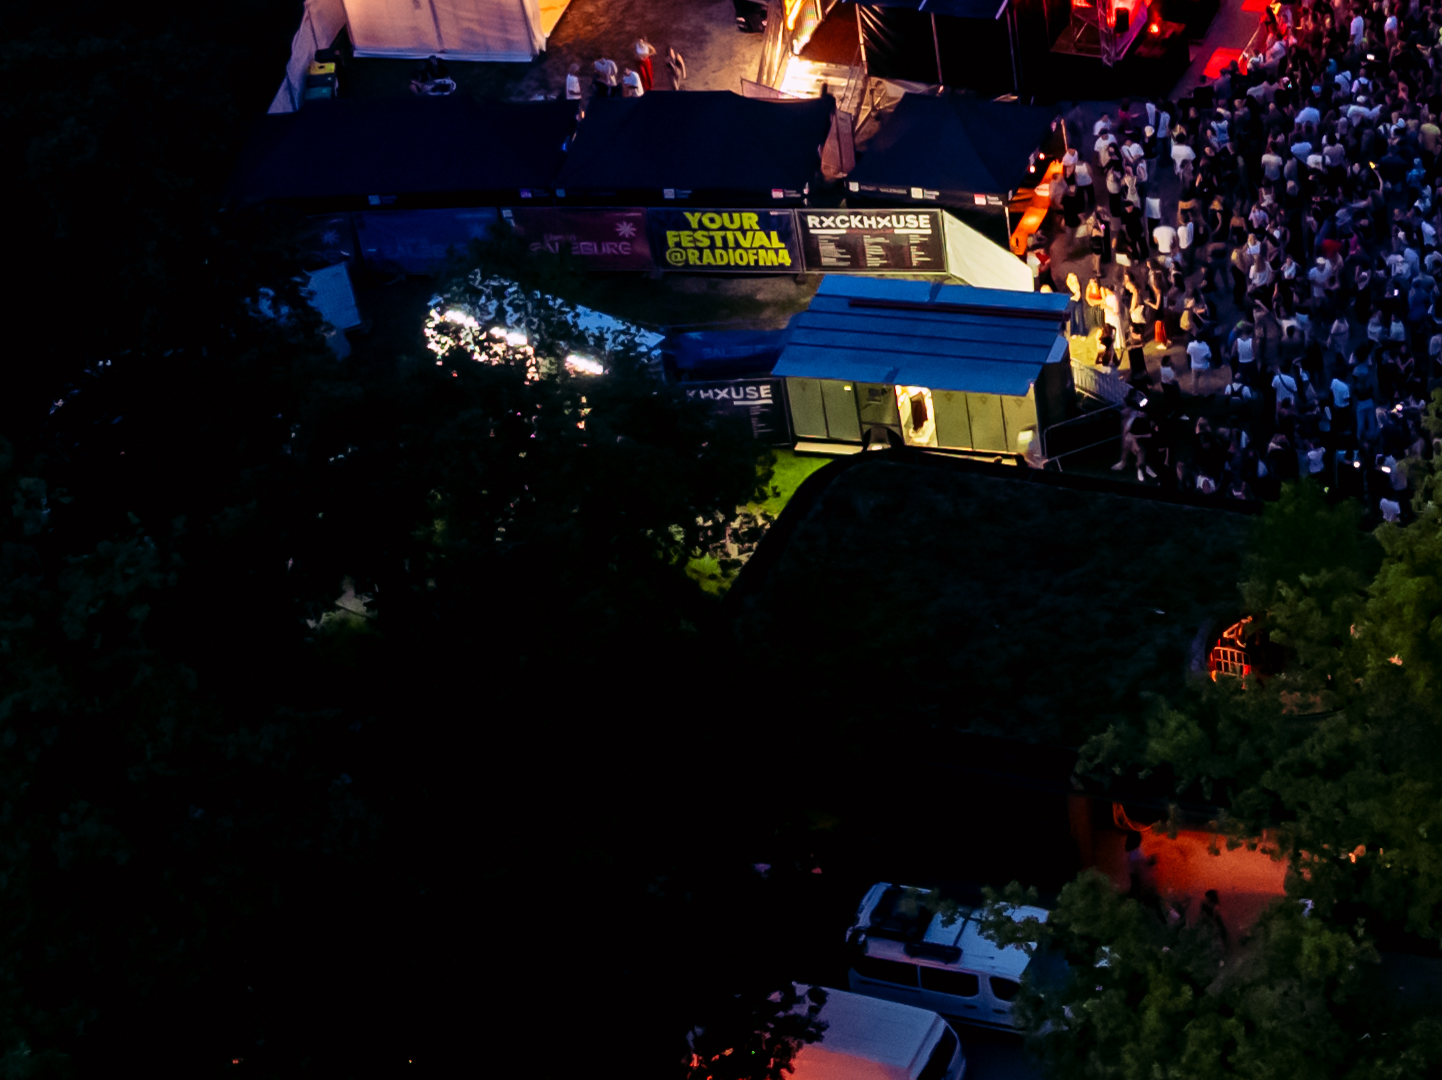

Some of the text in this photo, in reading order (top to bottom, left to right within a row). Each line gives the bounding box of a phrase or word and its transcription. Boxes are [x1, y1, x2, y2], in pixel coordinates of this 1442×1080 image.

[683, 211, 760, 229] YOUR
[807, 214, 931, 229] RXCKHXUSE
[666, 230, 786, 248] FESTIVAL
[666, 247, 792, 266] @RADIOFM4
[686, 384, 773, 401] KHXUSE
